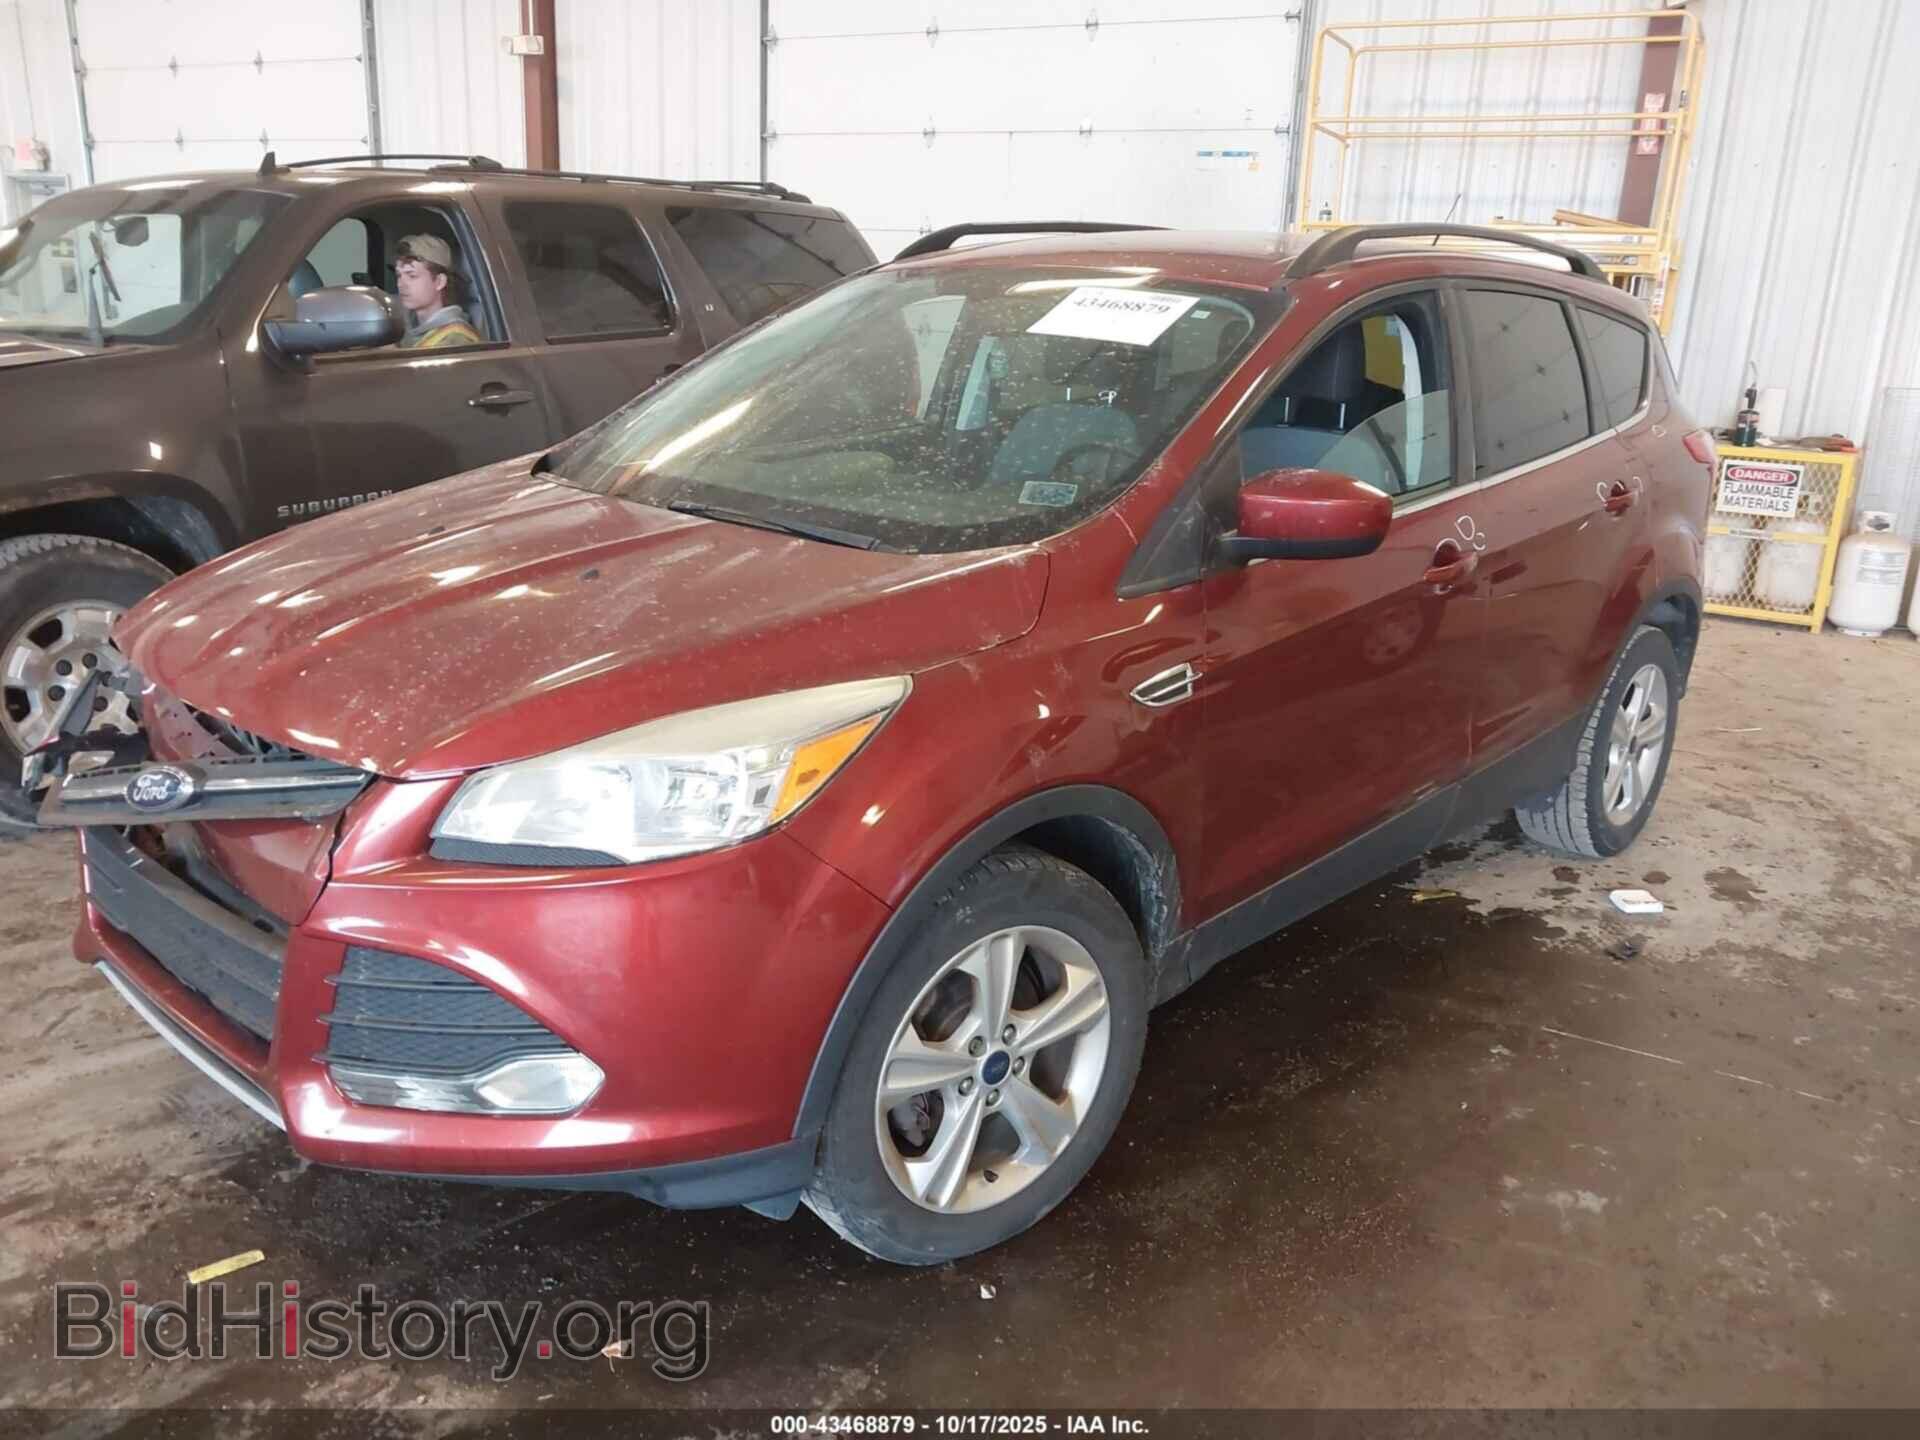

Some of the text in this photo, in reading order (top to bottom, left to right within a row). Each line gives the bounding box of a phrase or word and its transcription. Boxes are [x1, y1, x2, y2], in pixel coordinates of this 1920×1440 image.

[1073, 297, 1172, 313] 43468879
[1734, 467, 1790, 481] DANGER
[1724, 482, 1795, 499] FLAMMABLE
[1723, 495, 1790, 512] MATERIALS
